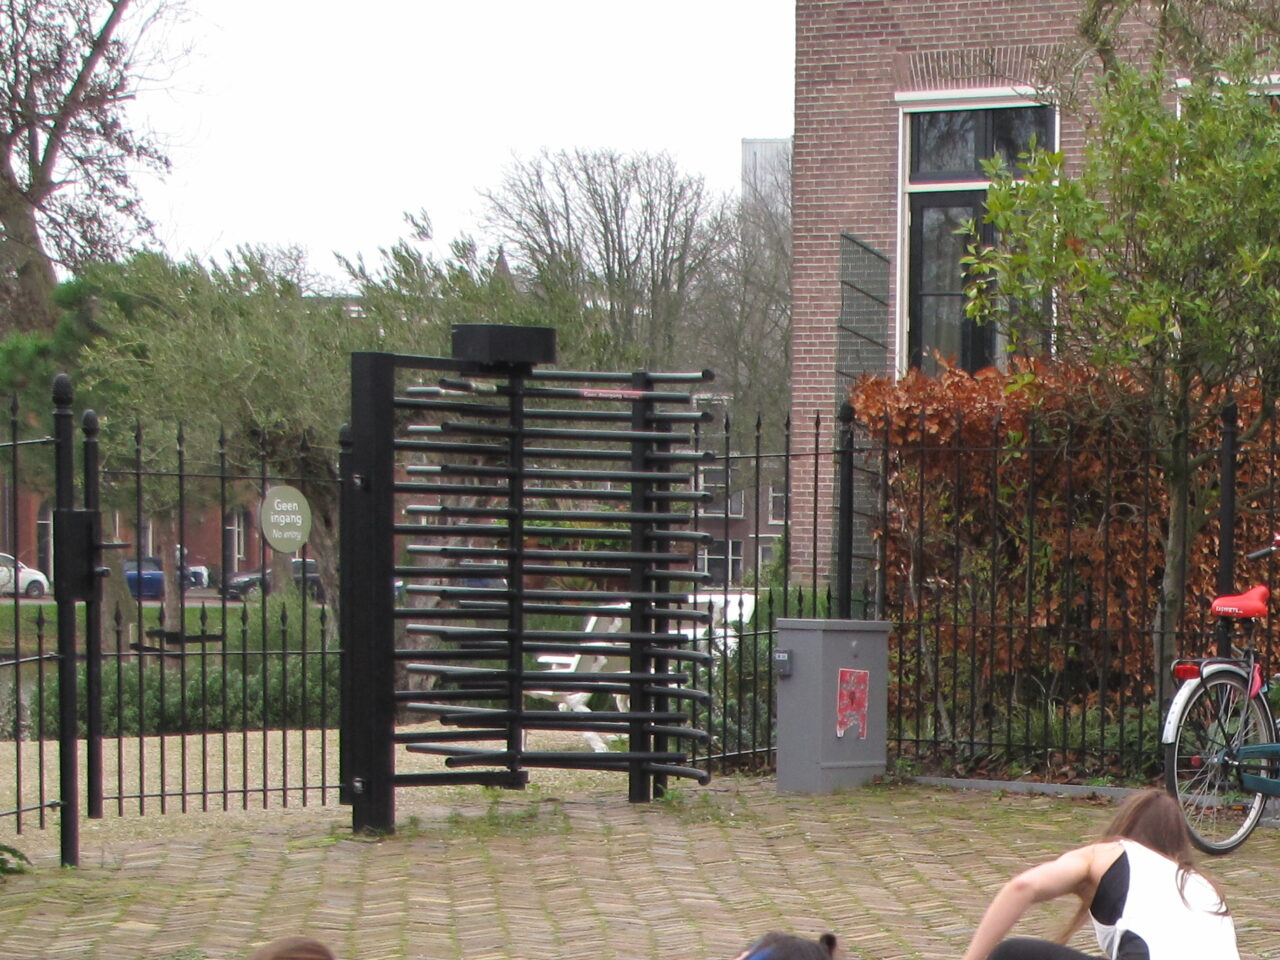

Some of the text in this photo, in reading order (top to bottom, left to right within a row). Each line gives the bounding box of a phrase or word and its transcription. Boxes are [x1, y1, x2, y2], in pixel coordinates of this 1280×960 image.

[274, 499, 298, 512] Geen
[271, 512, 302, 526] ingang
[272, 529, 302, 541] No entry
